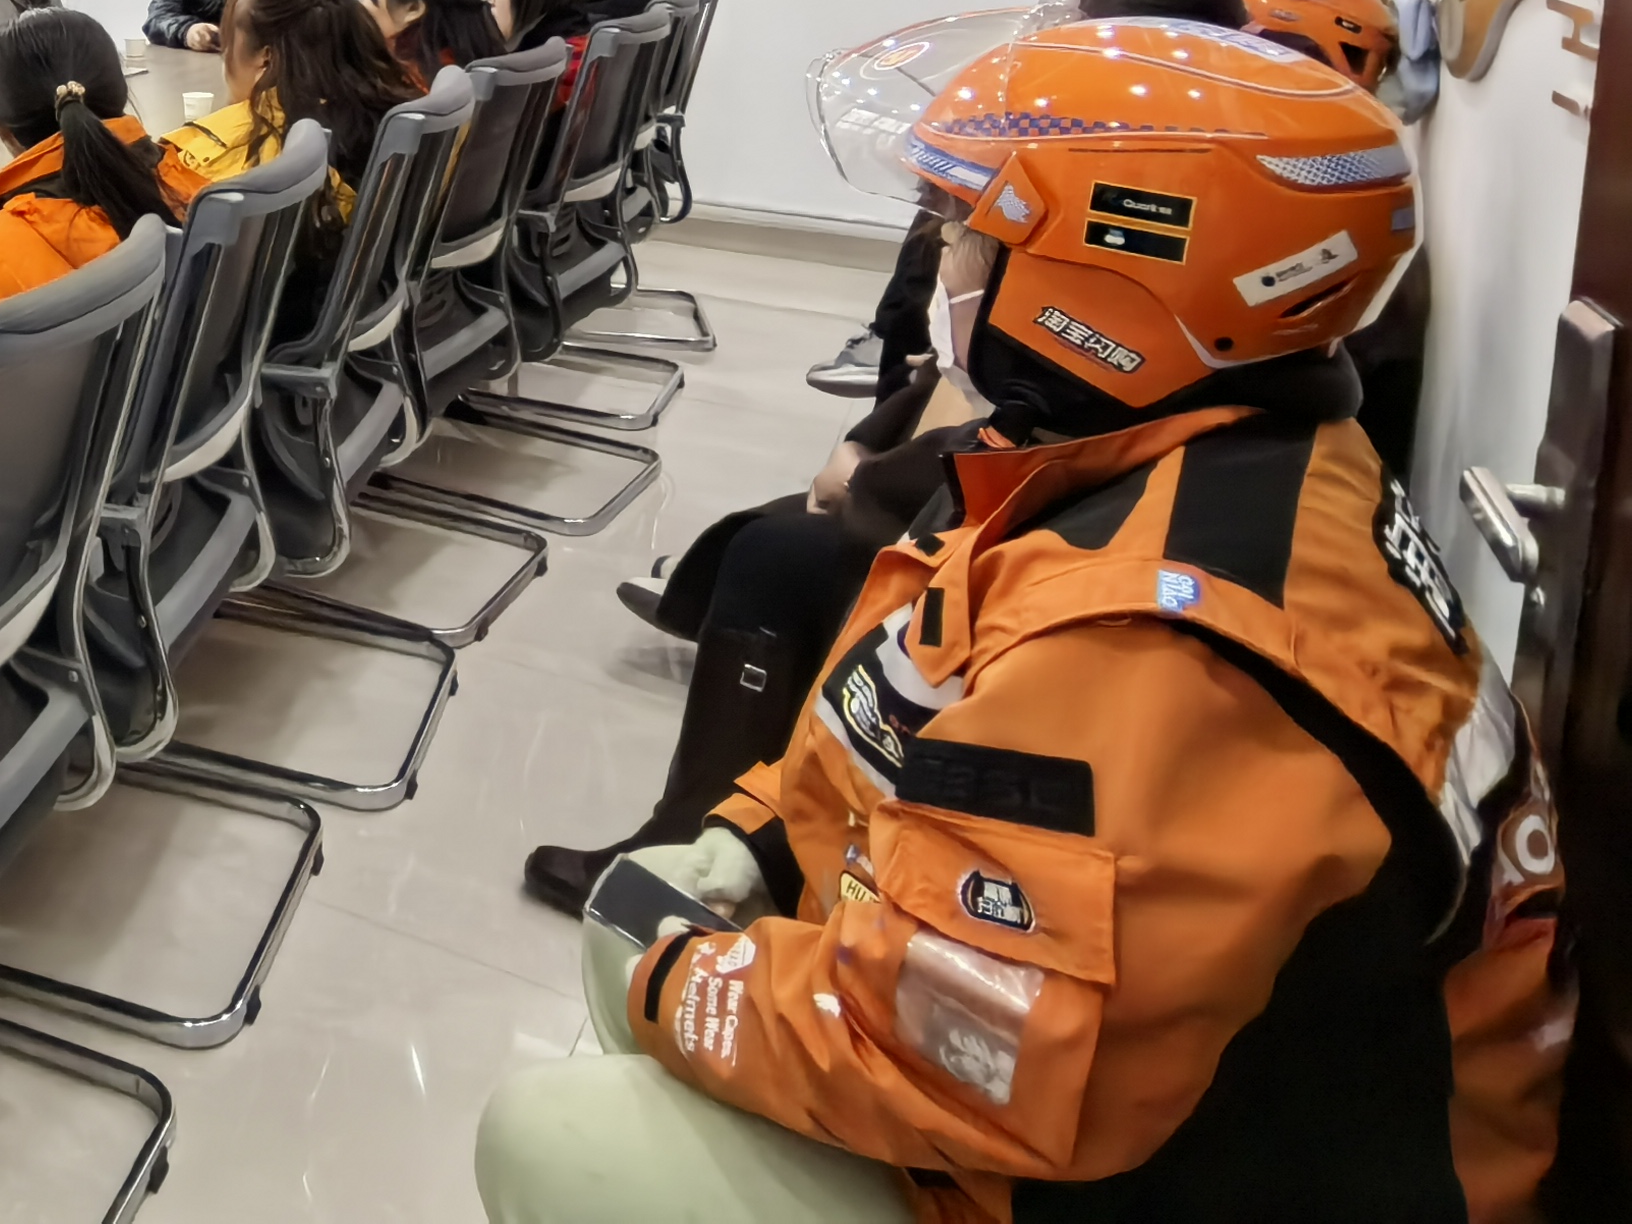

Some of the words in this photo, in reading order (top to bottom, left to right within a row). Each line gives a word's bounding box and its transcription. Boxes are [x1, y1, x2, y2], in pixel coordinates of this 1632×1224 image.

[1036, 307, 1143, 373] 淘宝闪购
[705, 975, 723, 1014] Some
